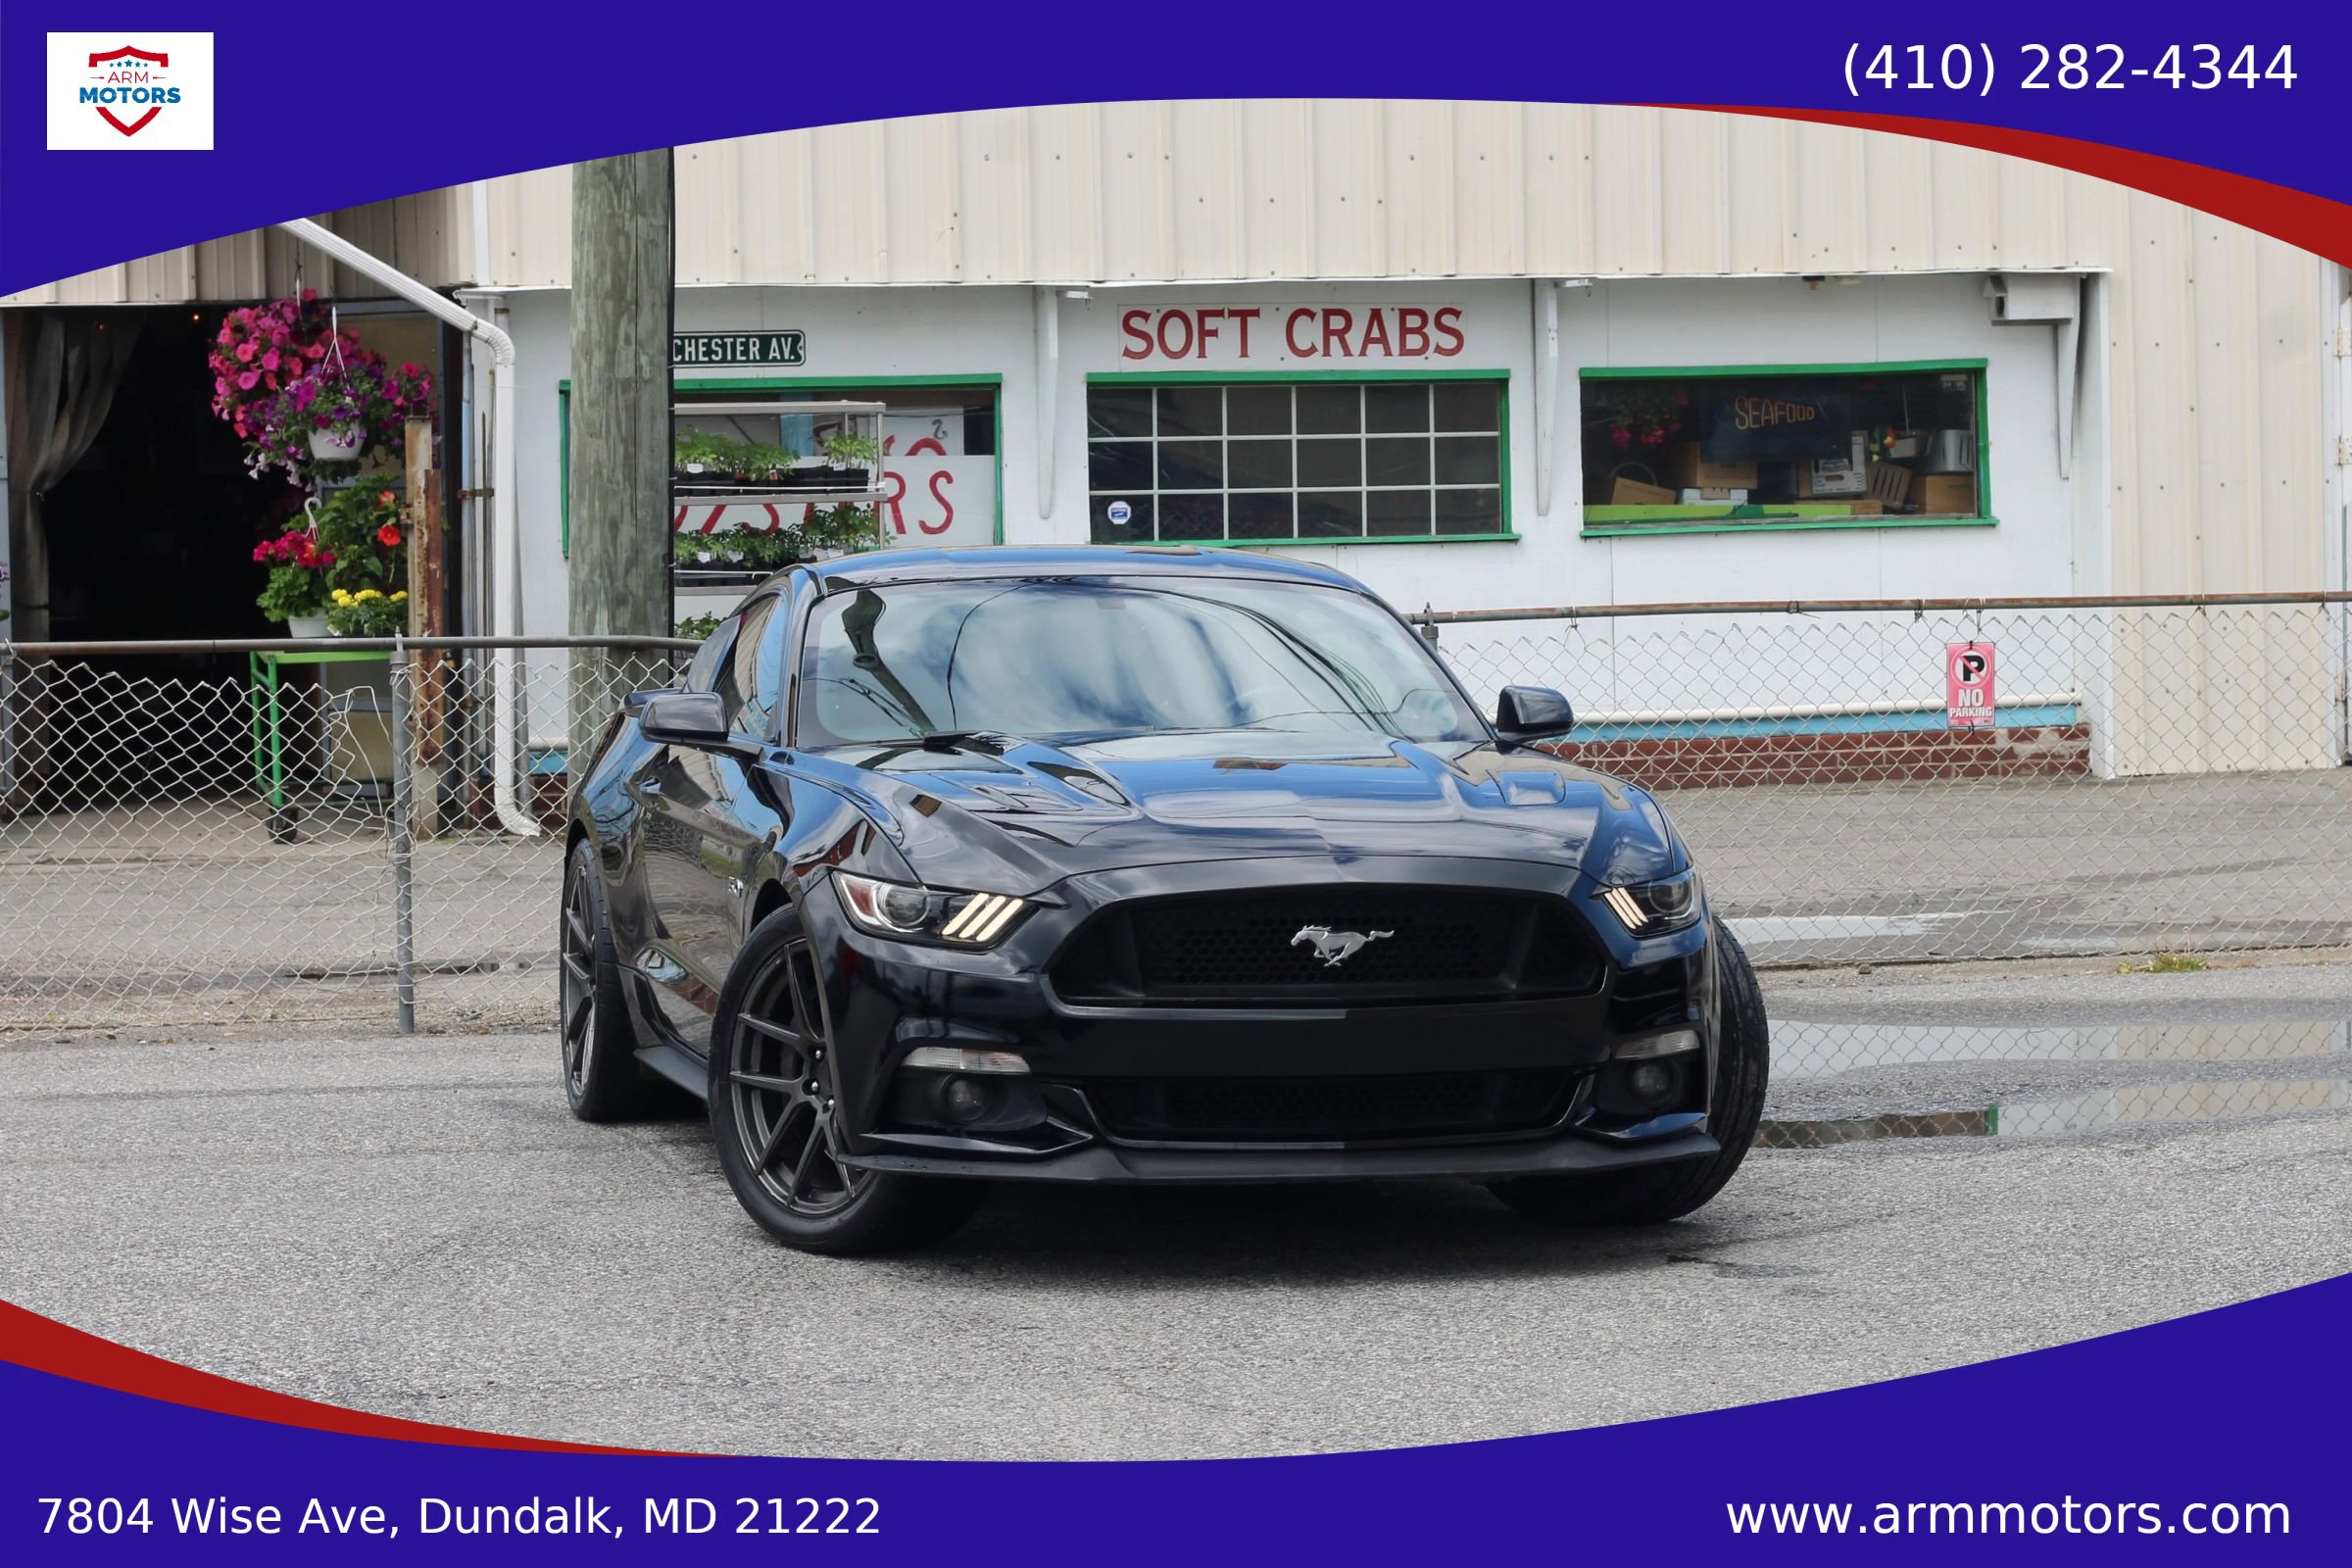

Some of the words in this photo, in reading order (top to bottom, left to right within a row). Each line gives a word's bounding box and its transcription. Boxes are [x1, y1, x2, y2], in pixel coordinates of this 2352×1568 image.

[1121, 307, 1260, 360] SOFT
[1285, 307, 1464, 359] CRABS
[768, 336, 795, 361] AV.
[1735, 395, 1815, 430] SEAFOOD
[1958, 688, 1984, 708] NO
[1950, 706, 1992, 717] PARKING
